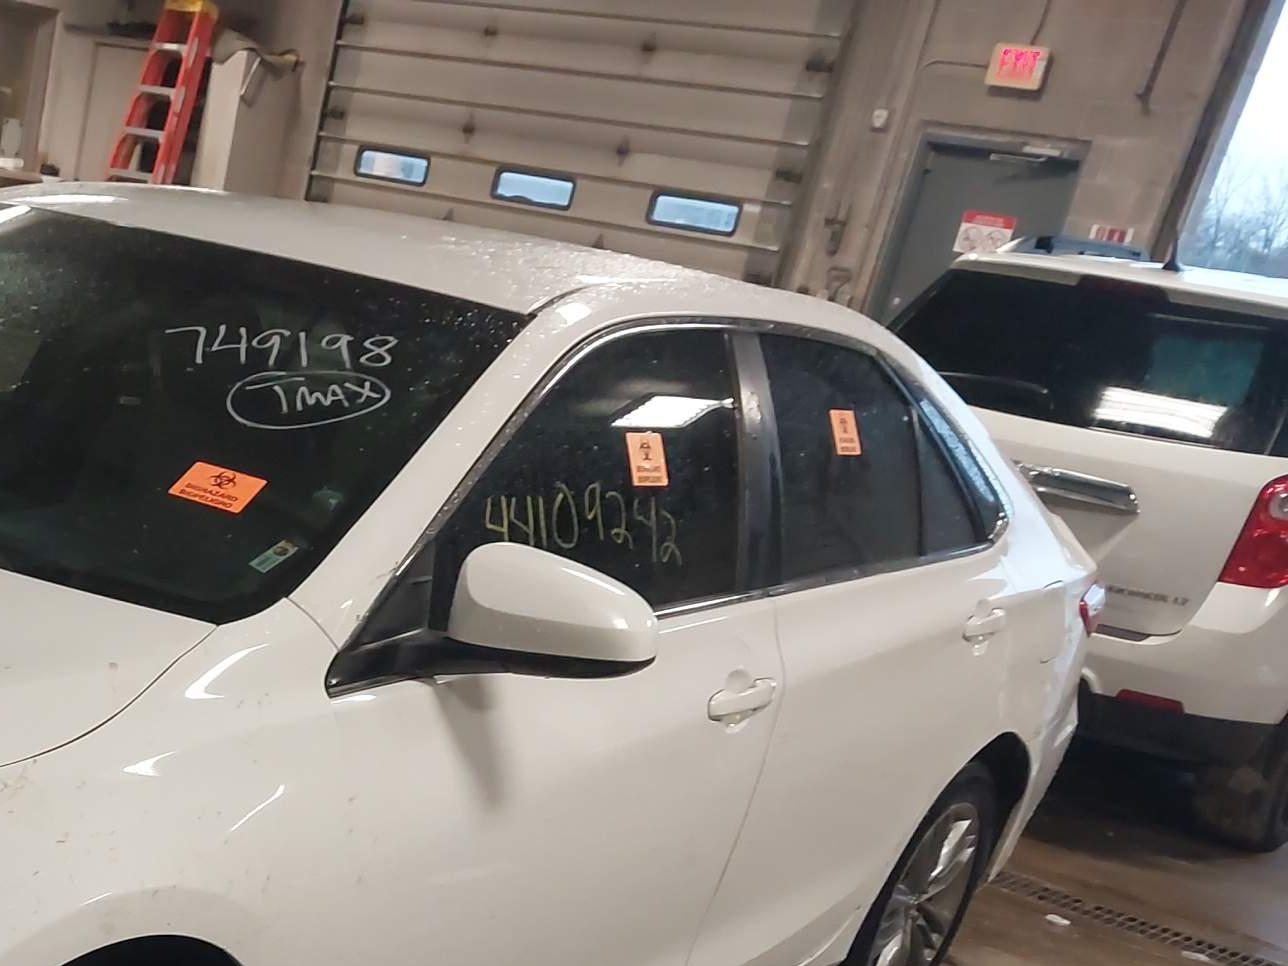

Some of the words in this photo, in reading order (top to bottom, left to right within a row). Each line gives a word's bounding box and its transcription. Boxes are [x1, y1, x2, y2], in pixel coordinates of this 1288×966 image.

[999, 48, 1041, 78] EXIT
[164, 323, 399, 370] 749198
[244, 376, 382, 414] TMAX
[485, 480, 683, 567] 44109242
